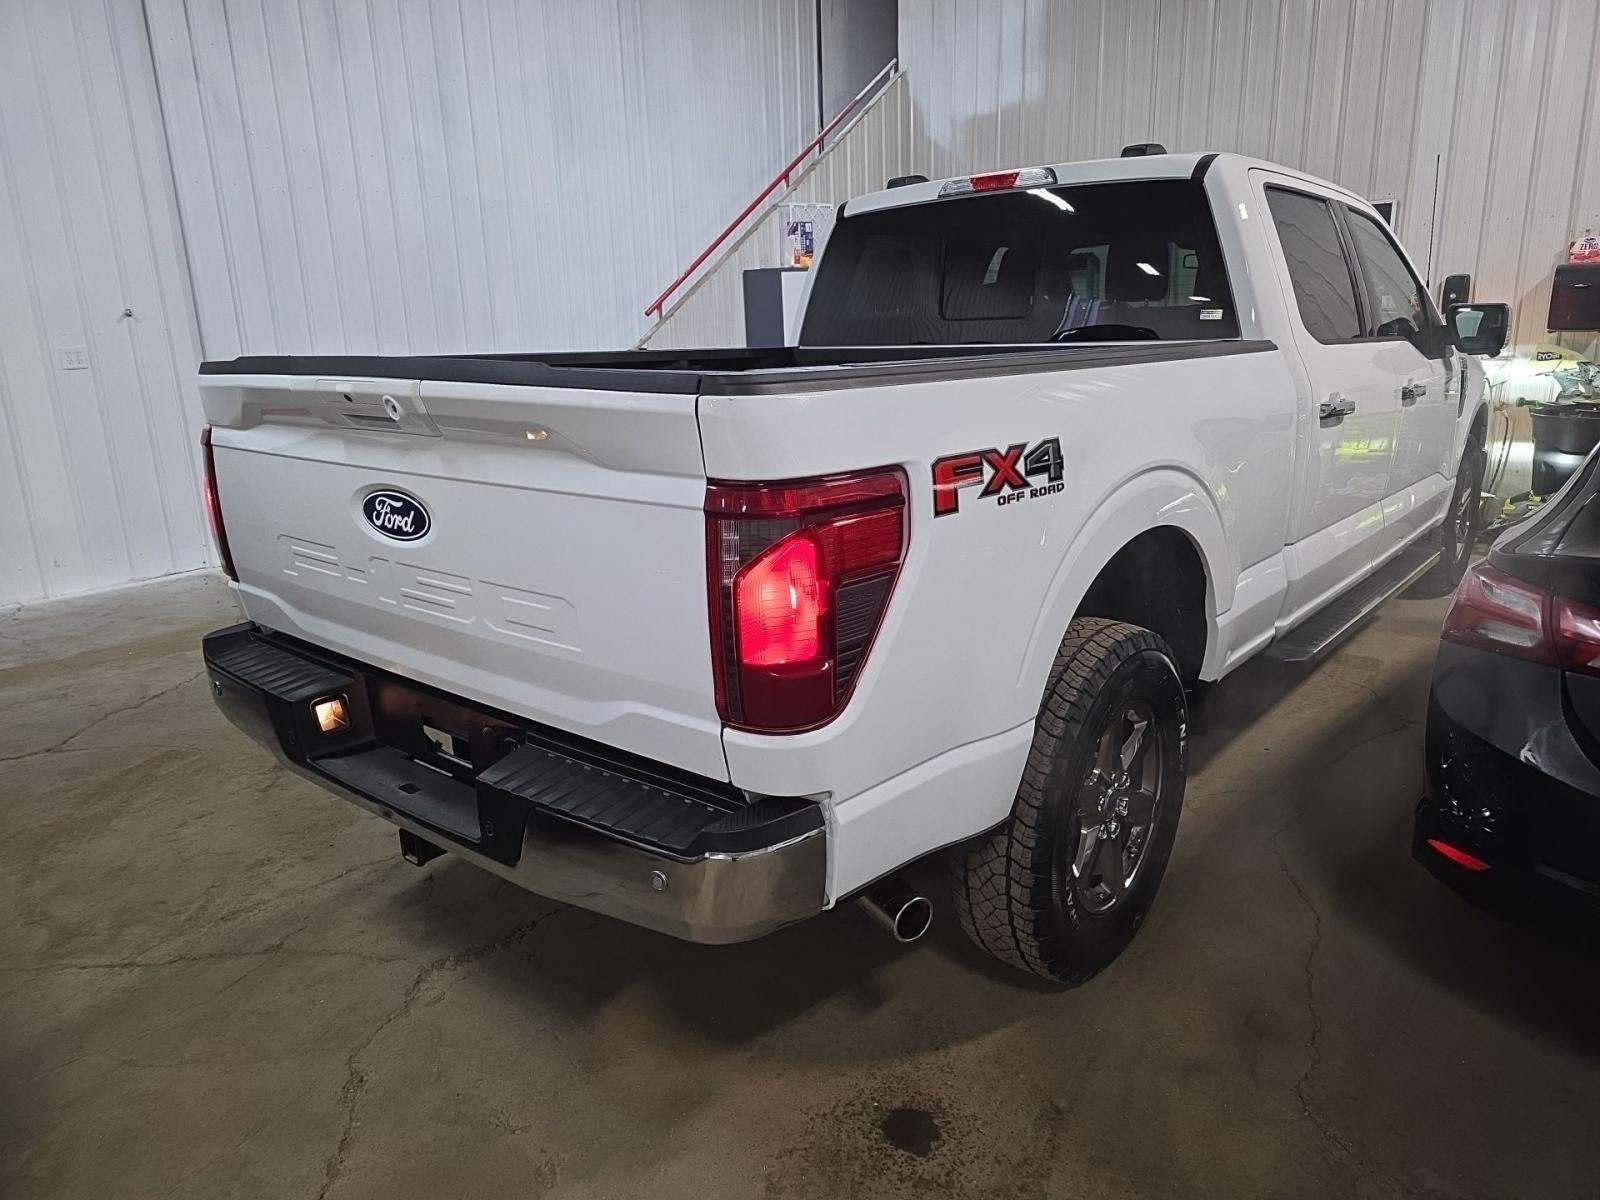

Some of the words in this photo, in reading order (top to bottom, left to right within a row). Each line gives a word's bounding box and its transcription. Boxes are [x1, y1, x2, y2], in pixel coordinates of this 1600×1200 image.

[930, 436, 1064, 519] FX4
[997, 491, 1025, 506] OFF
[1030, 483, 1065, 499] ROAD
[372, 496, 415, 533] Ford
[277, 534, 583, 652] F-150
